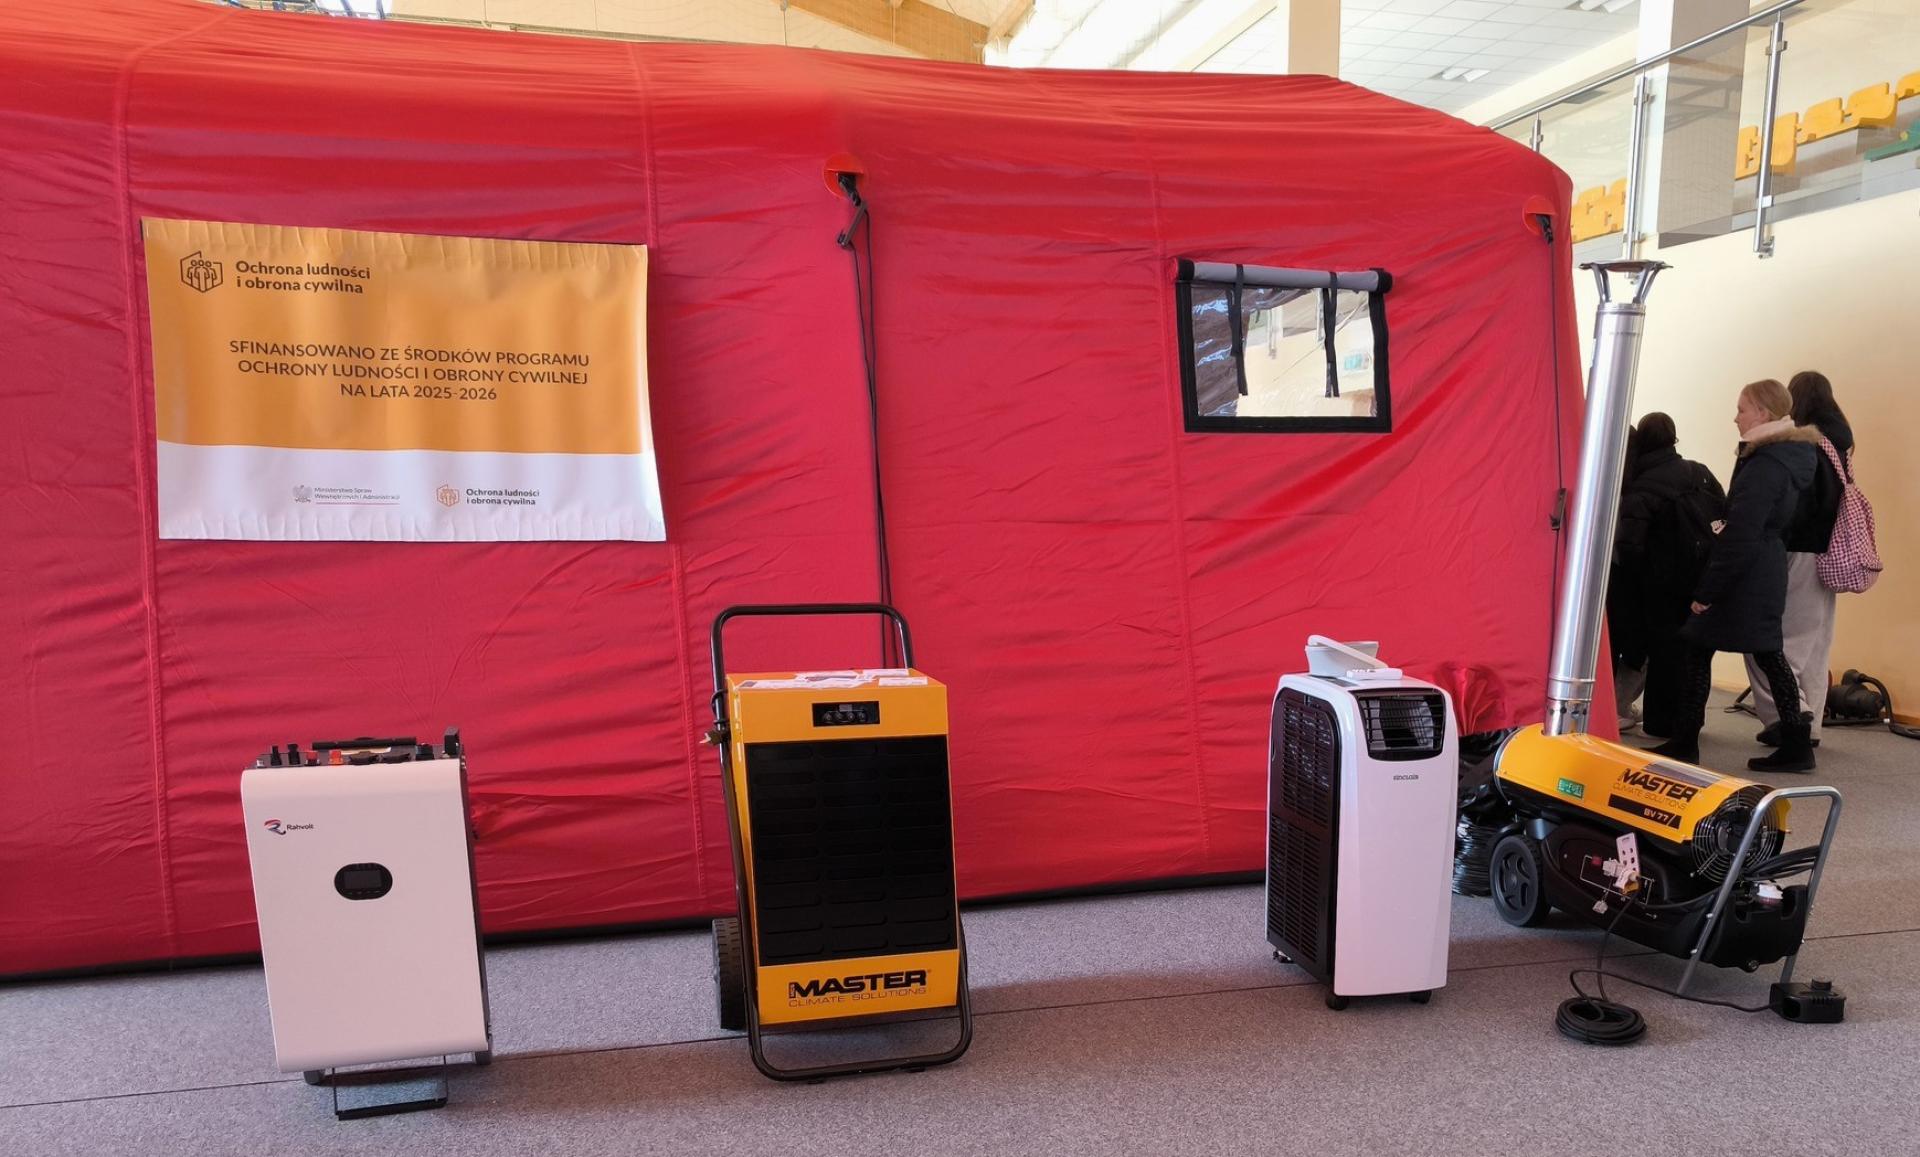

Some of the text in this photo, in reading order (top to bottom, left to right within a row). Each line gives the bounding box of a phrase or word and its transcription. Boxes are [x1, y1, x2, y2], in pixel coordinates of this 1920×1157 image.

[236, 260, 371, 279] Ochrona ludności
[236, 276, 363, 294] i obrona cywilna
[229, 340, 589, 367] SFINANSOWANO ZE ŚRODKÓW PROGRAMU
[238, 360, 588, 385] OCHRONY LUDNOŚCI I OBRONY CYWILNEJ
[340, 383, 497, 400] NA LATA 2025-2026
[354, 487, 372, 495] Spraw
[466, 488, 540, 497] Ochrona ludności
[471, 497, 502, 505] obrona
[503, 498, 536, 506] cywilna
[1622, 768, 1699, 803] MASTER
[1657, 811, 1669, 822] 77
[793, 969, 927, 998] MASTER
[789, 988, 927, 1008] CLIMATE SOLUTIONS
